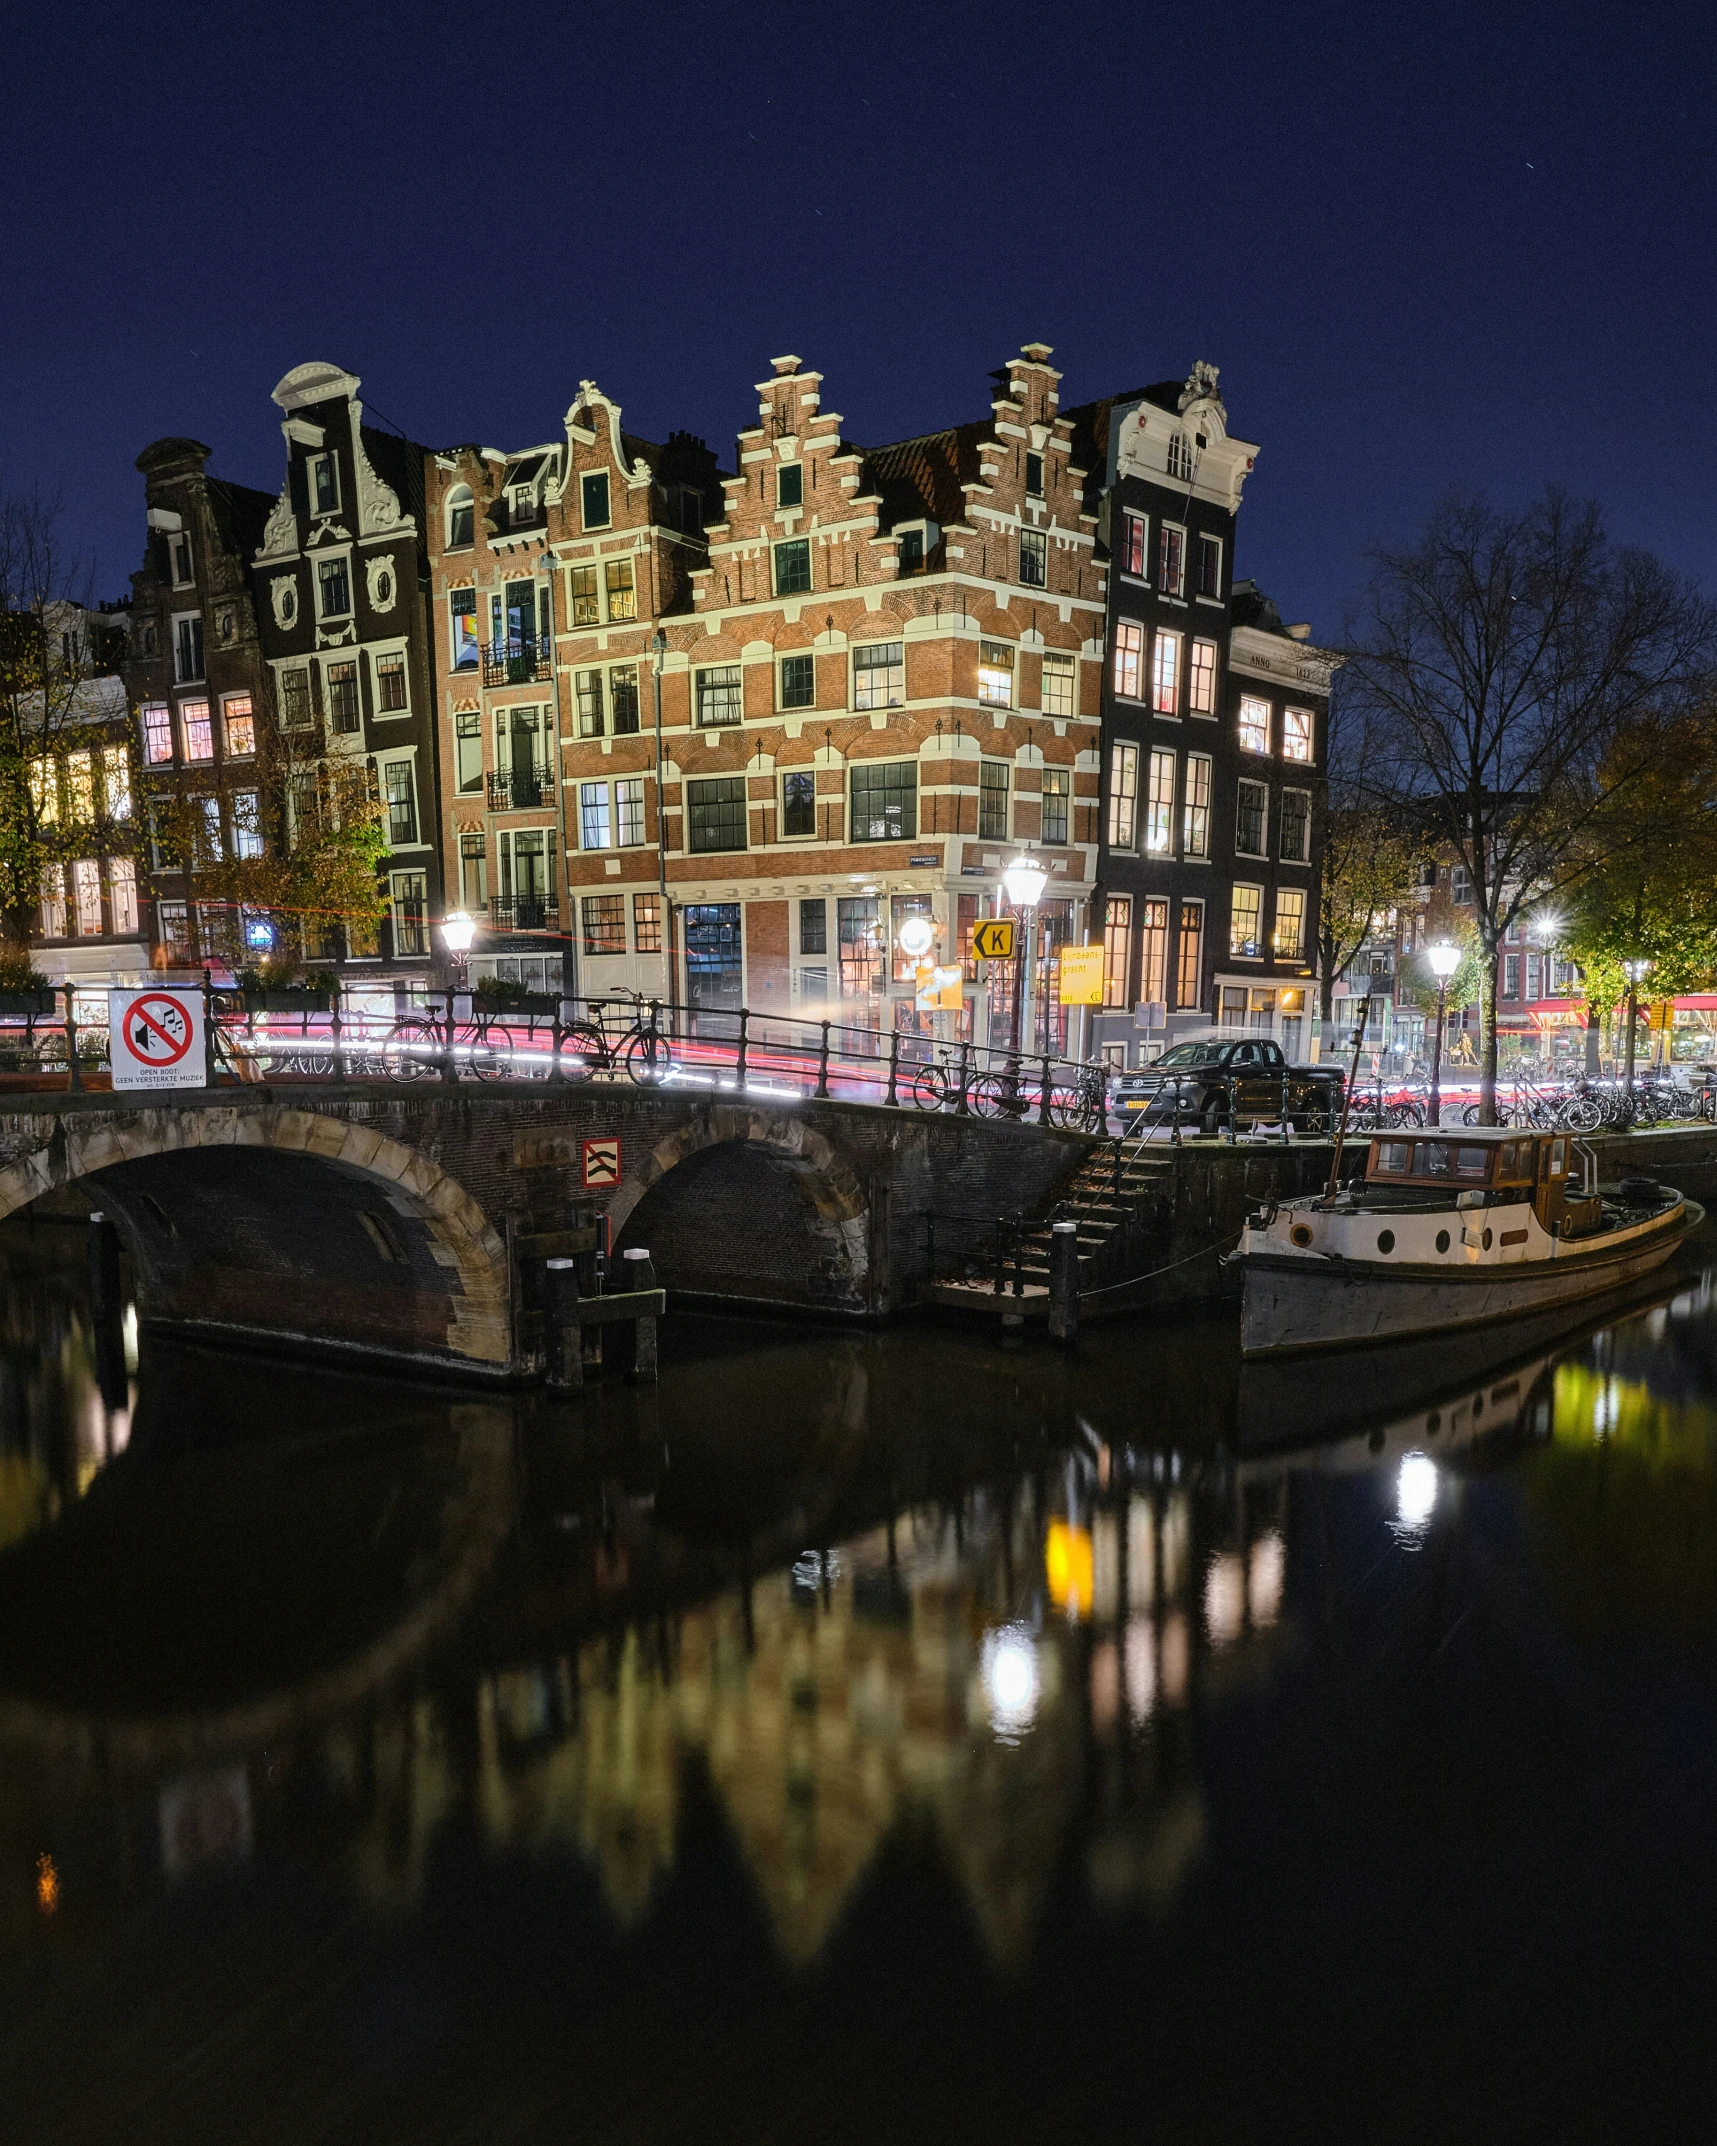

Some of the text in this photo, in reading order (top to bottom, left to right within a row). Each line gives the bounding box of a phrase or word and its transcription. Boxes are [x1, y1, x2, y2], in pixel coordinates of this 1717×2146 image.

[1250, 655, 1270, 668] ANNO
[991, 929, 1004, 951] K
[1063, 965, 1086, 976] gracht
[139, 1068, 158, 1076] OPEN
